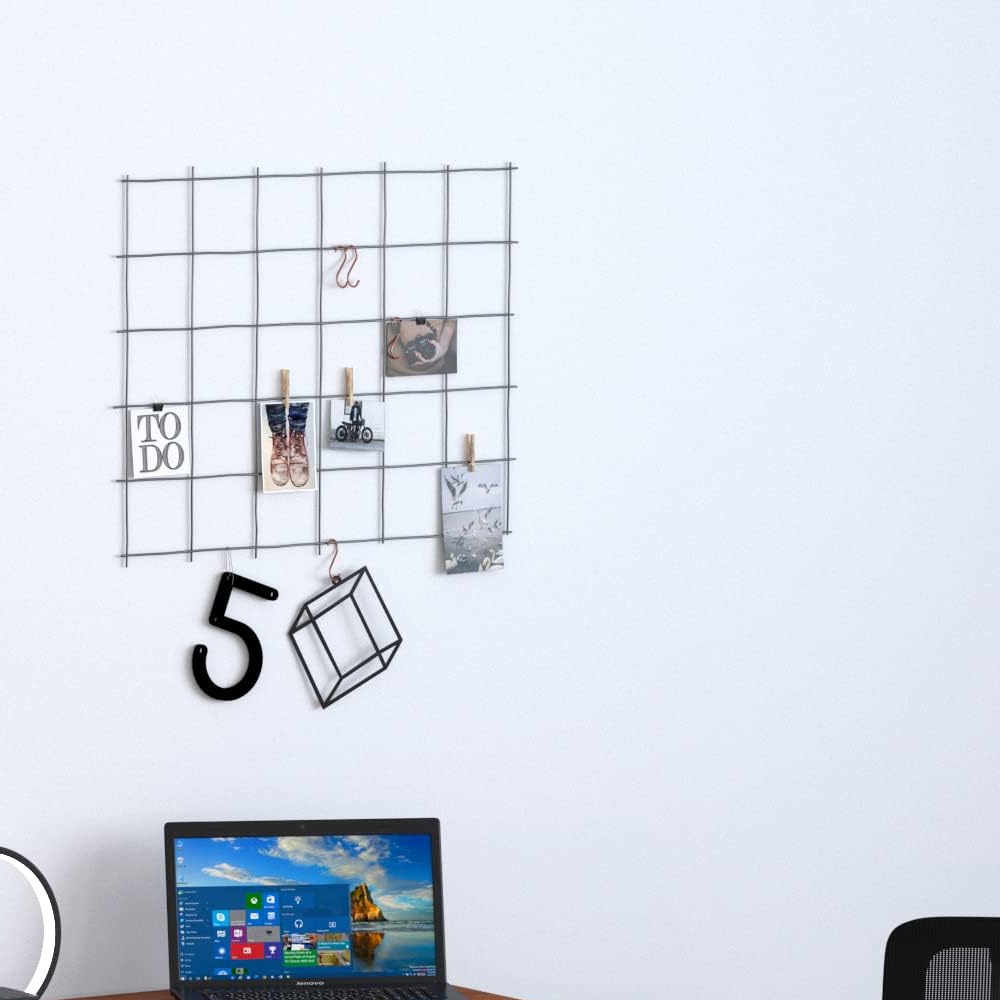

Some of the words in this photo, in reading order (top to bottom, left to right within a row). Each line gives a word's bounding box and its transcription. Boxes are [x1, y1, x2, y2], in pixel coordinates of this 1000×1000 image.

[136, 411, 182, 443] TO
[138, 441, 185, 473] DO
[192, 571, 279, 702] 5
